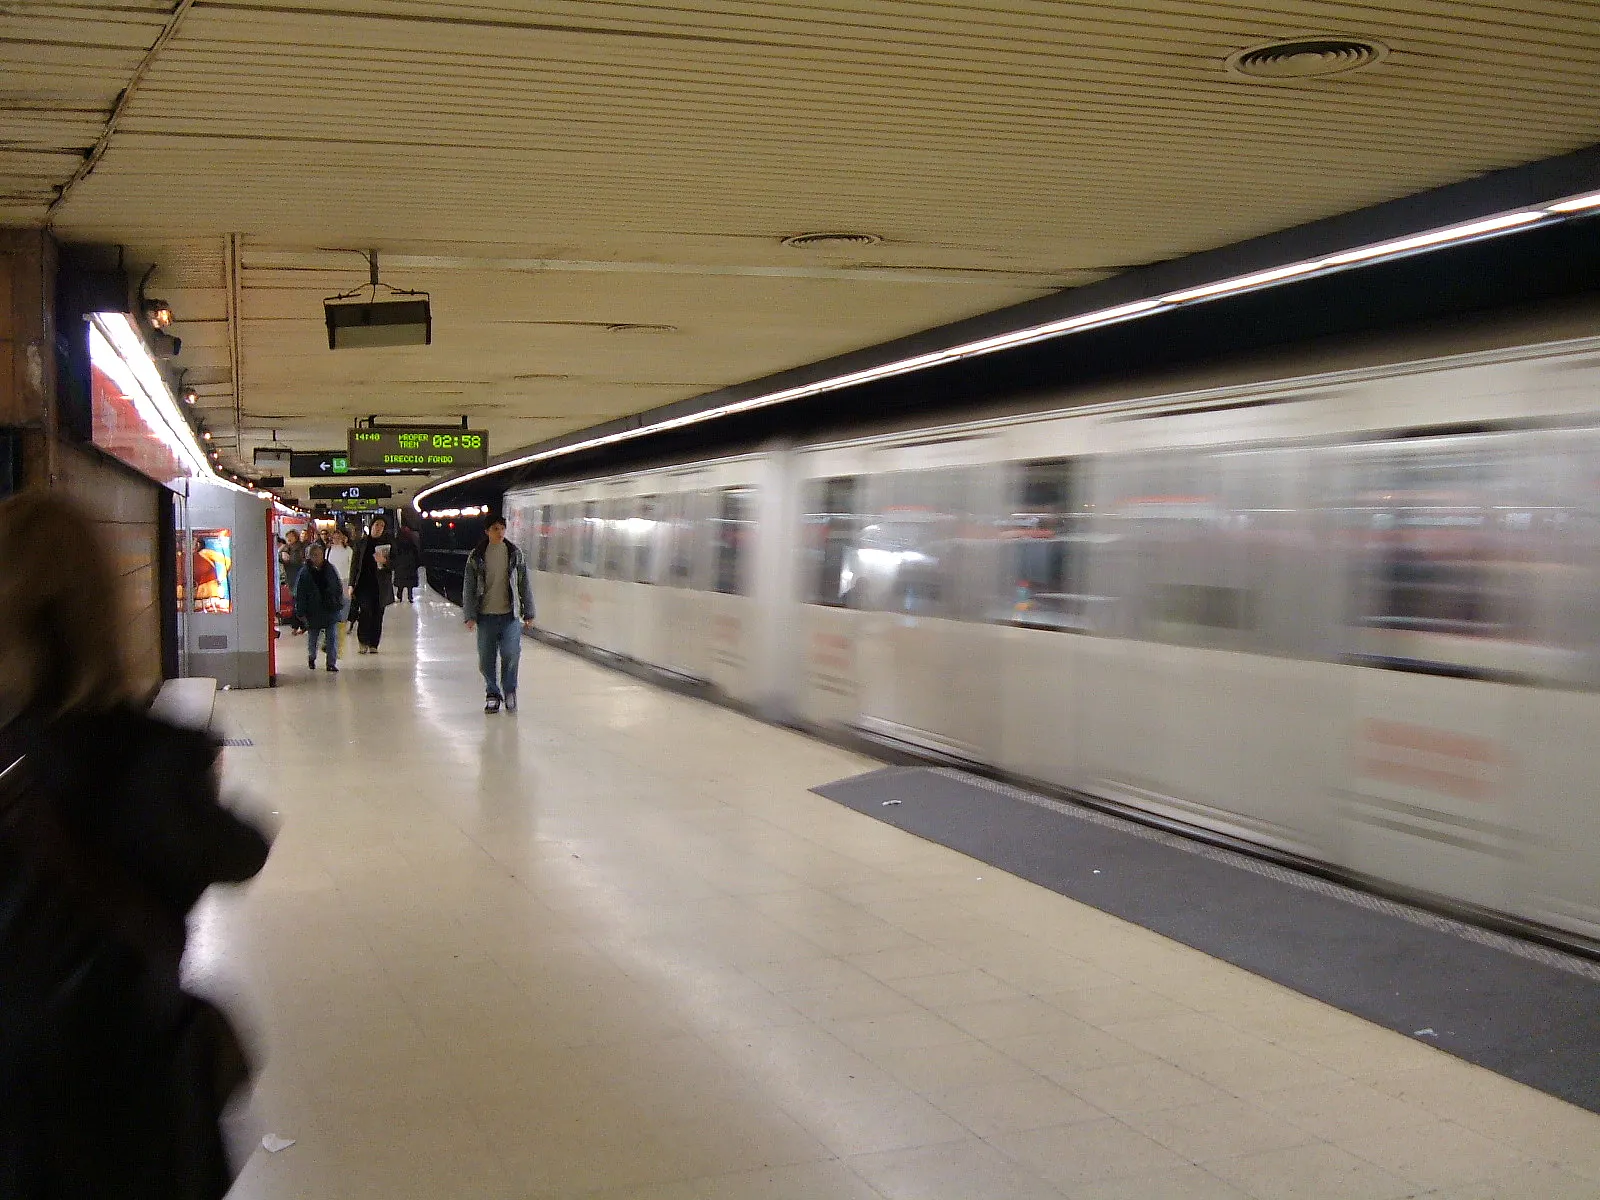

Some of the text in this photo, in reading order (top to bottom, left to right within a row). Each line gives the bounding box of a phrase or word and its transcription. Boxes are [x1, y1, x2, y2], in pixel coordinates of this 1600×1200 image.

[433, 434, 481, 448] 02:58
[428, 455, 453, 463] FONDO
[333, 460, 346, 468] L3
